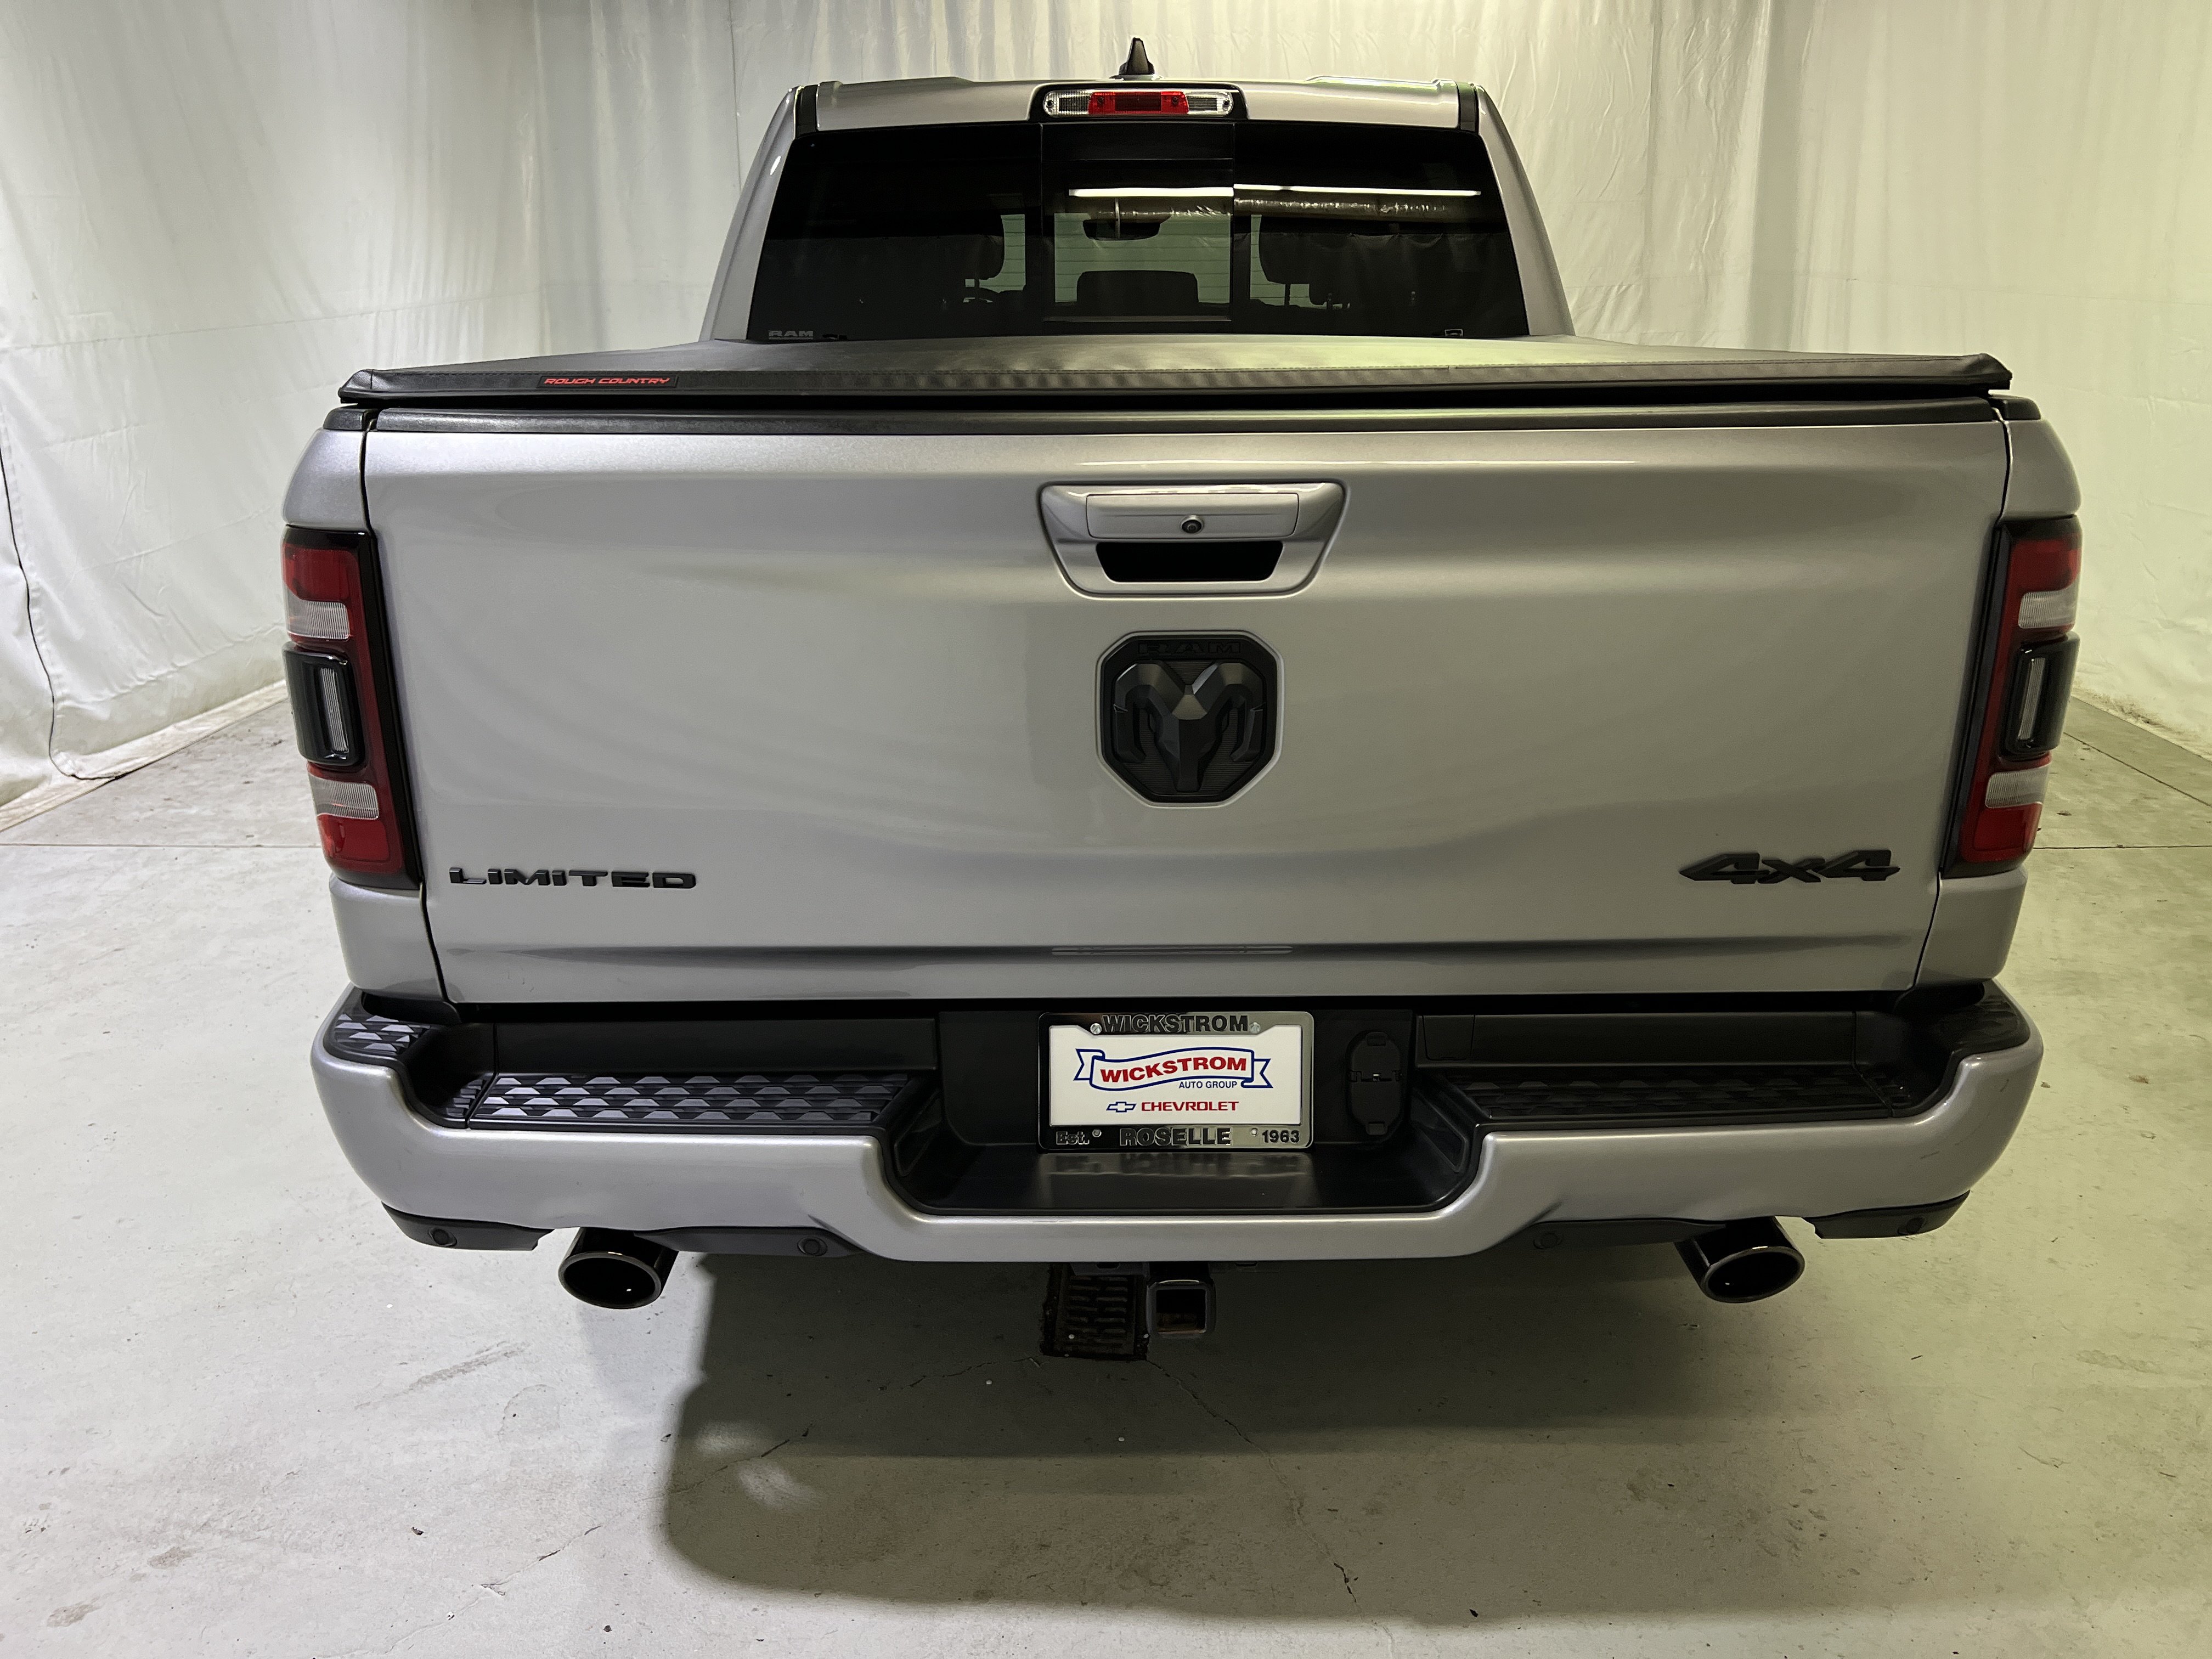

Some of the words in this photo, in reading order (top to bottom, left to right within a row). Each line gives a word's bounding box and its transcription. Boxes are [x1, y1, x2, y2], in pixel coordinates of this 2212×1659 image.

[449, 867, 697, 889] LIMITED
[1102, 1014, 1248, 1033] WICKSTROM
[1101, 1057, 1247, 1082] WICKSTROM
[1141, 1101, 1239, 1111] CHEVROLET
[1056, 1131, 1090, 1145] Est.
[1120, 1127, 1232, 1146] ROSELLE
[1262, 1130, 1300, 1143] 1963
